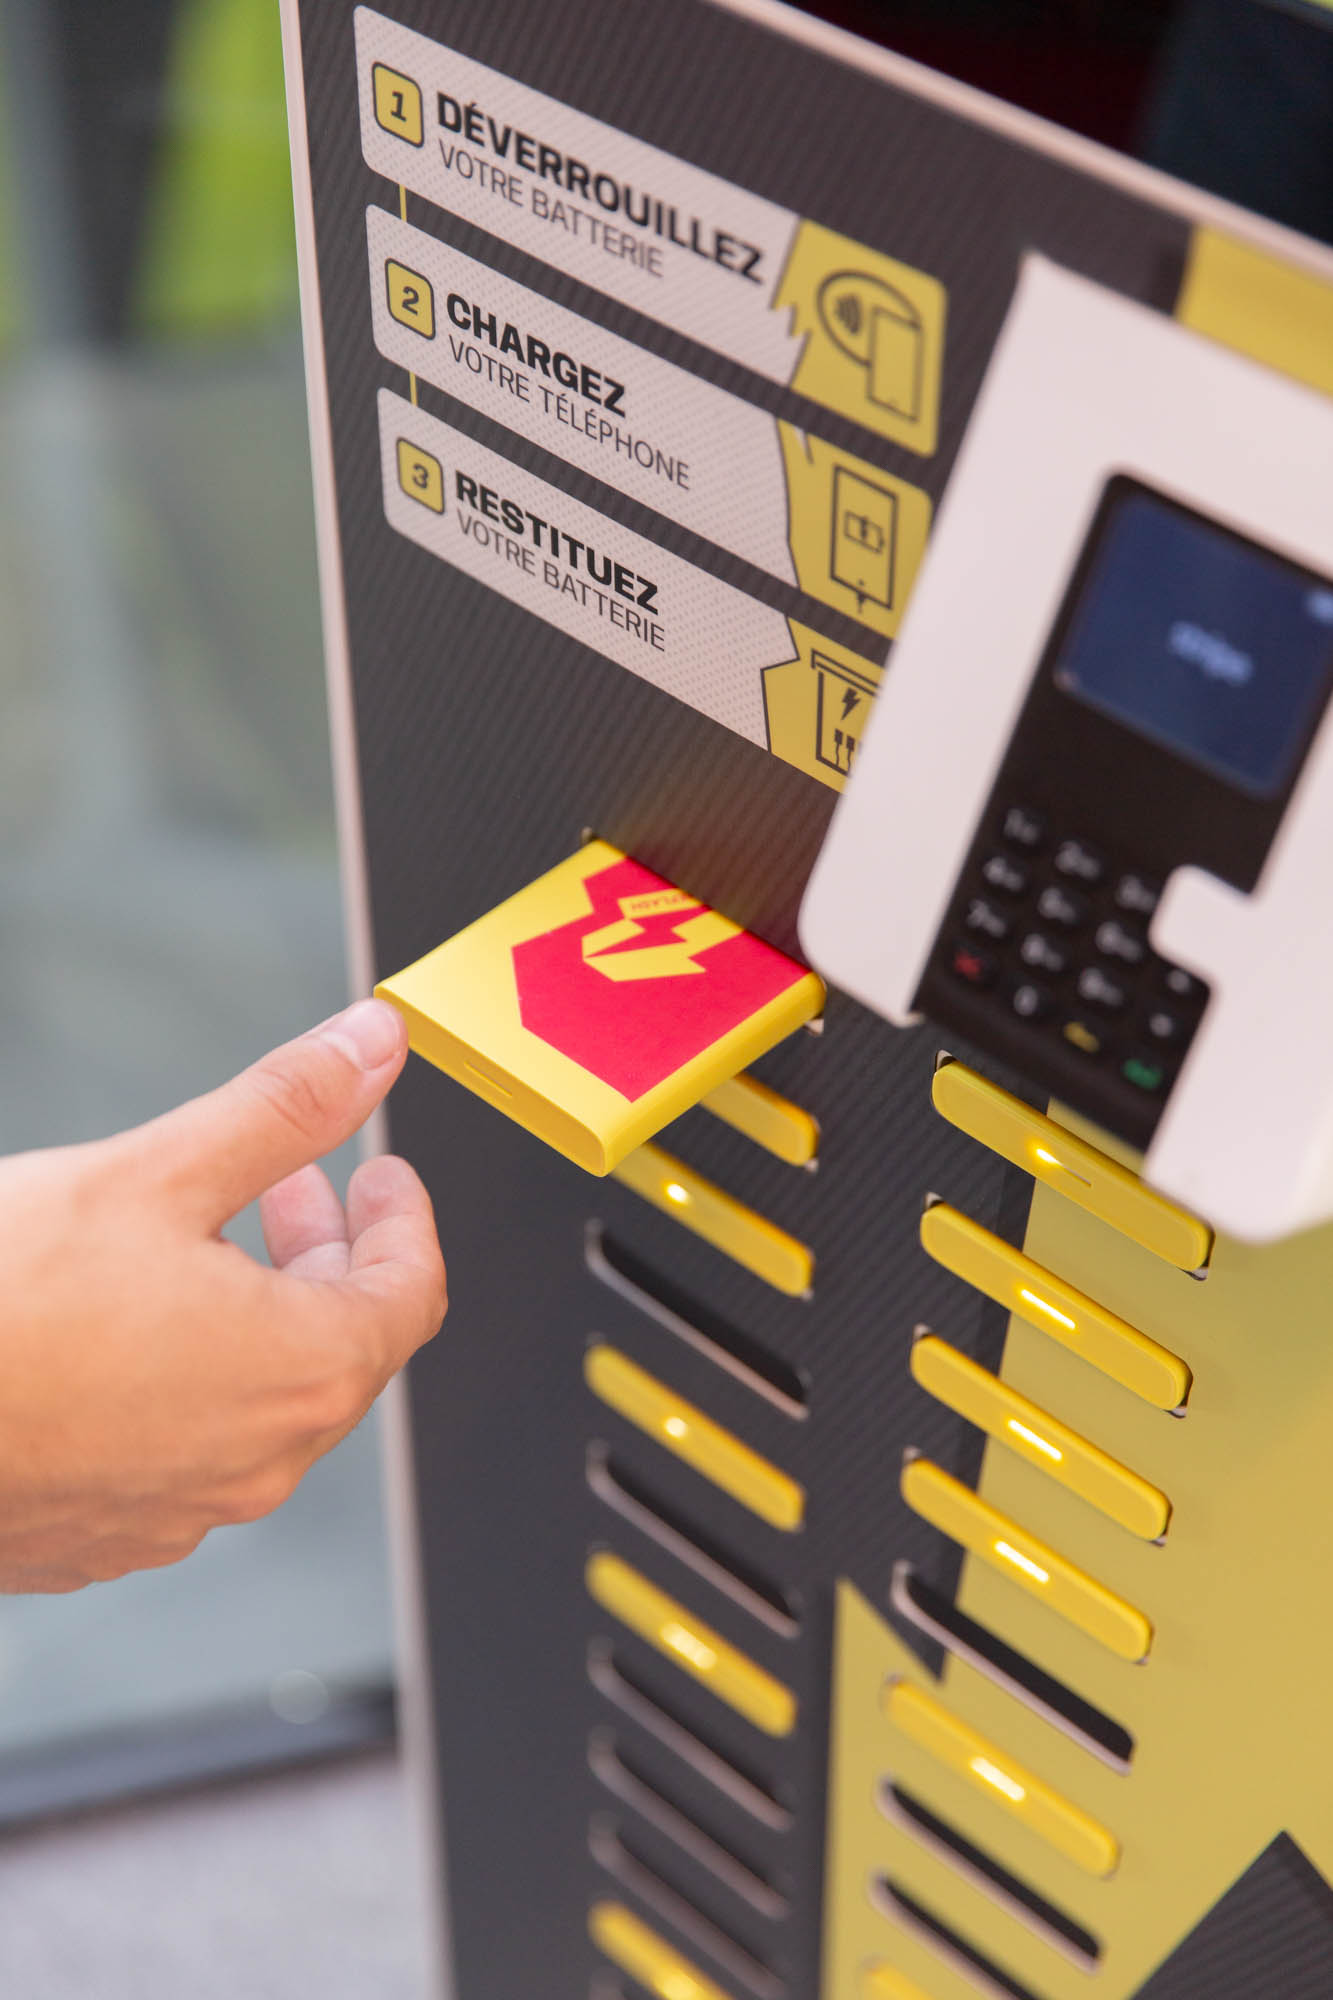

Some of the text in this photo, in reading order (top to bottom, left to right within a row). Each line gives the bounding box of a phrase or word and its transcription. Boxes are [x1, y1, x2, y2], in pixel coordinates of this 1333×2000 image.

[391, 90, 407, 122] 1
[437, 91, 763, 284] DÉVERROUILLEZ
[438, 138, 663, 278] VOTRE BATTERIE
[401, 285, 420, 316] 2
[446, 292, 626, 417] CHARGEZ
[412, 463, 429, 490] 3
[448, 334, 690, 490] VOTRE TÉLÉPHONE
[456, 470, 658, 615] RESTITUEZ
[456, 508, 665, 652] VOTRE BATTERIE
